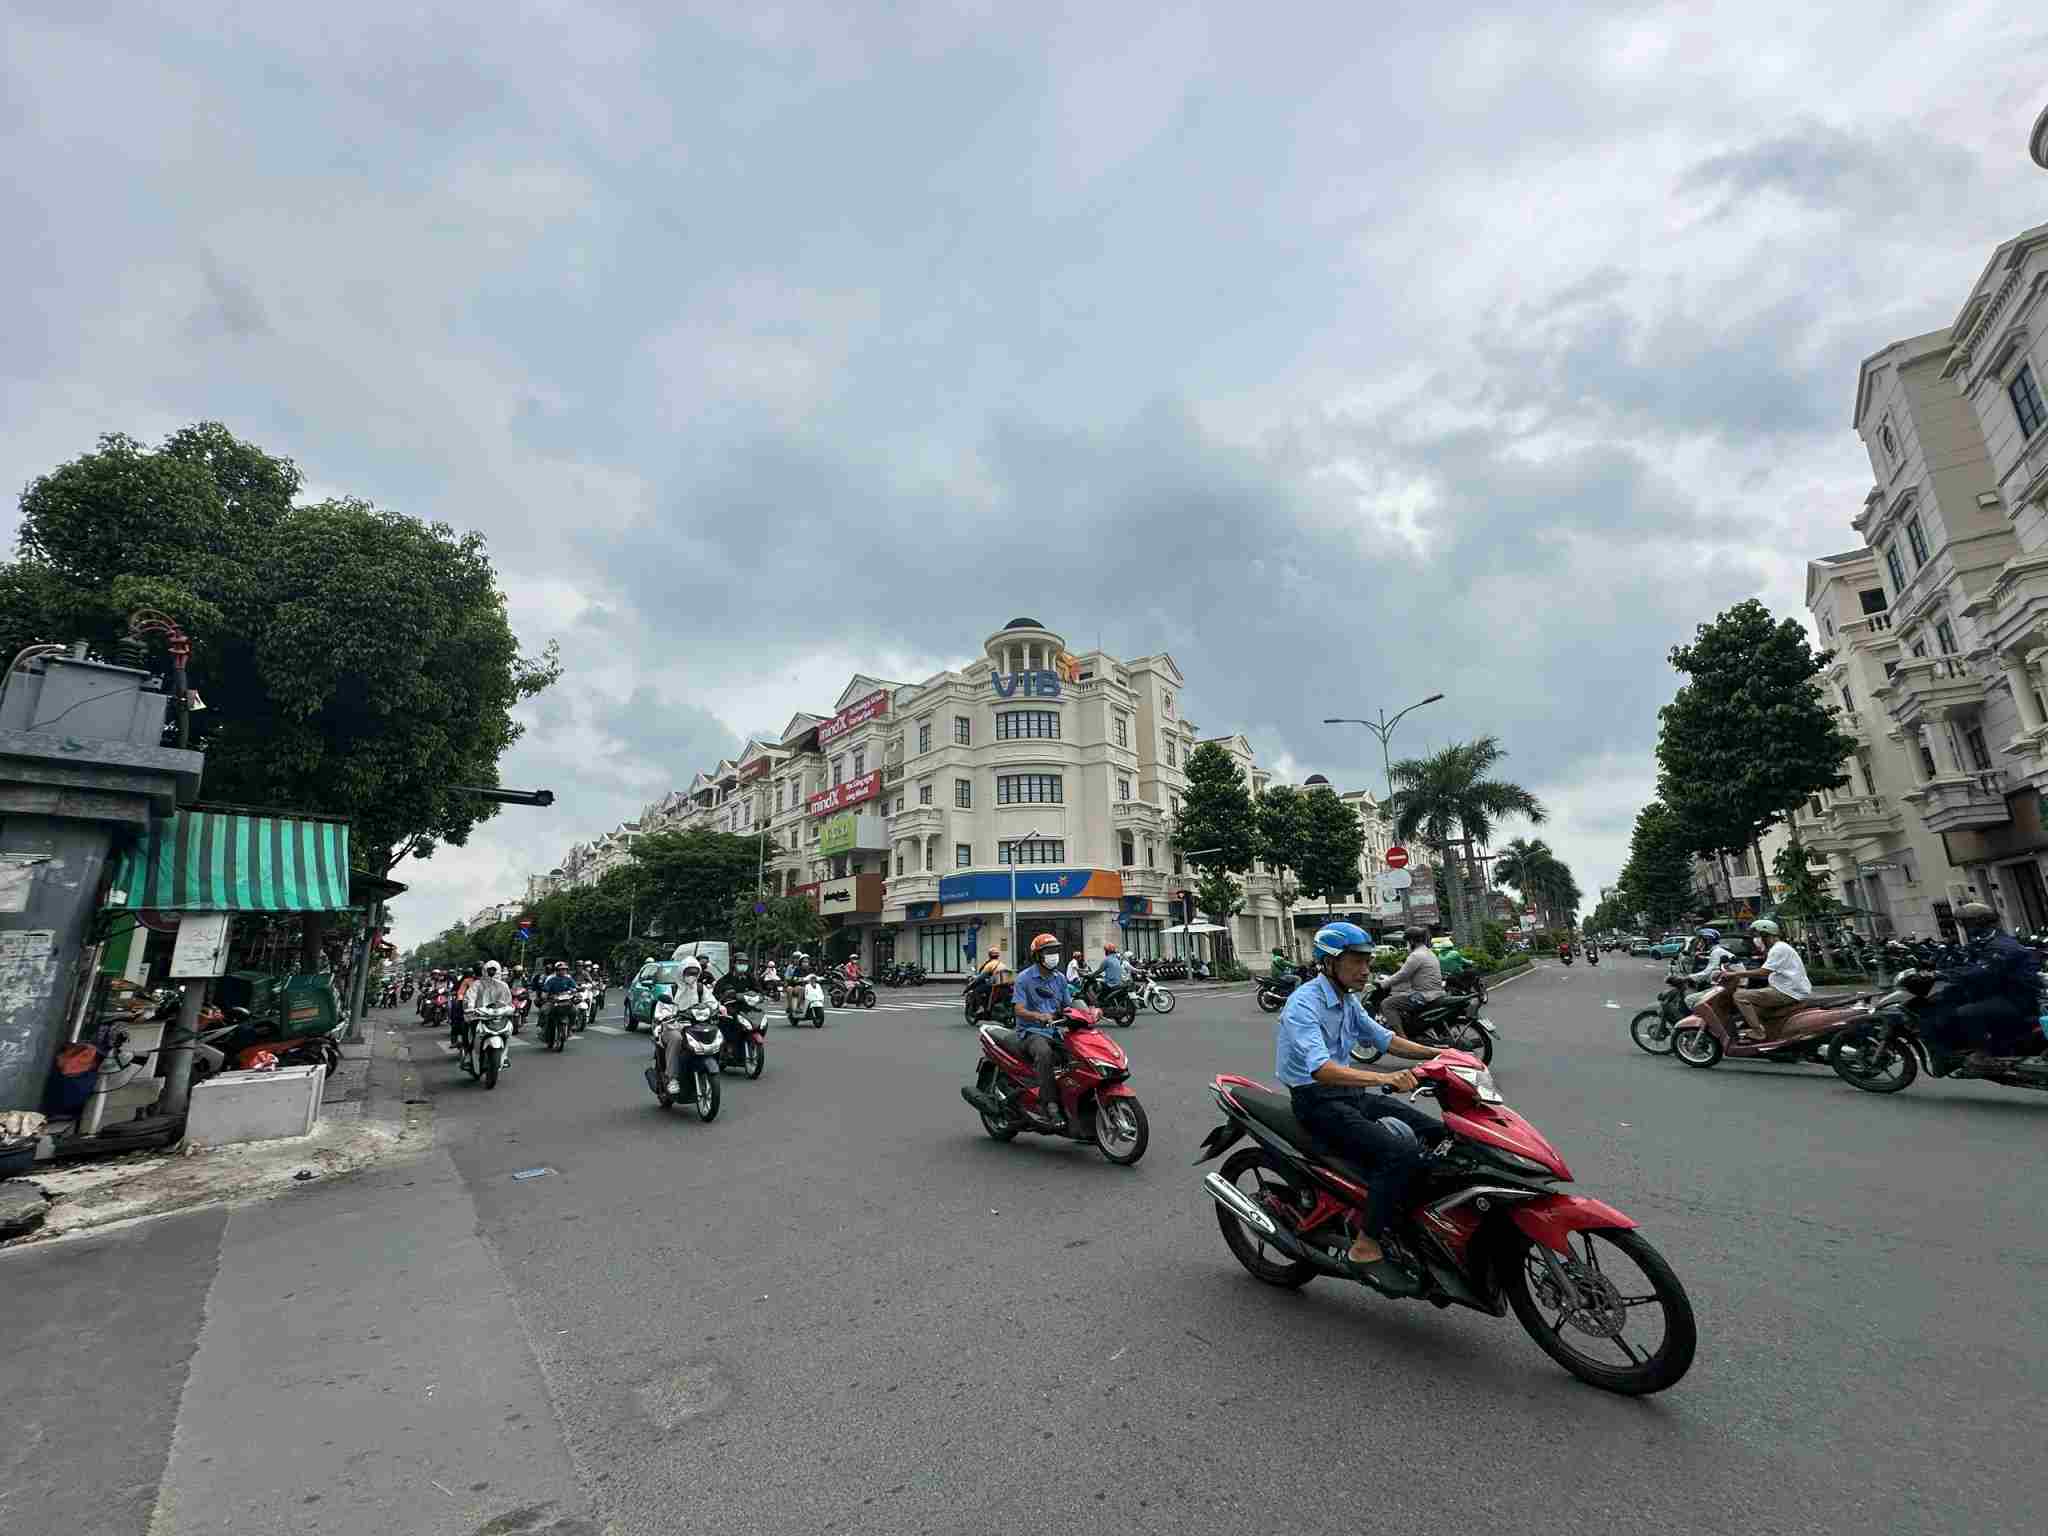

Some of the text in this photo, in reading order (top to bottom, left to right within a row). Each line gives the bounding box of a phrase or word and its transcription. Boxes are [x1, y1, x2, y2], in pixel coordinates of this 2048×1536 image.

[992, 671, 1060, 697] VIB
[811, 788, 840, 815] mindX
[1034, 883, 1060, 894] VIB
